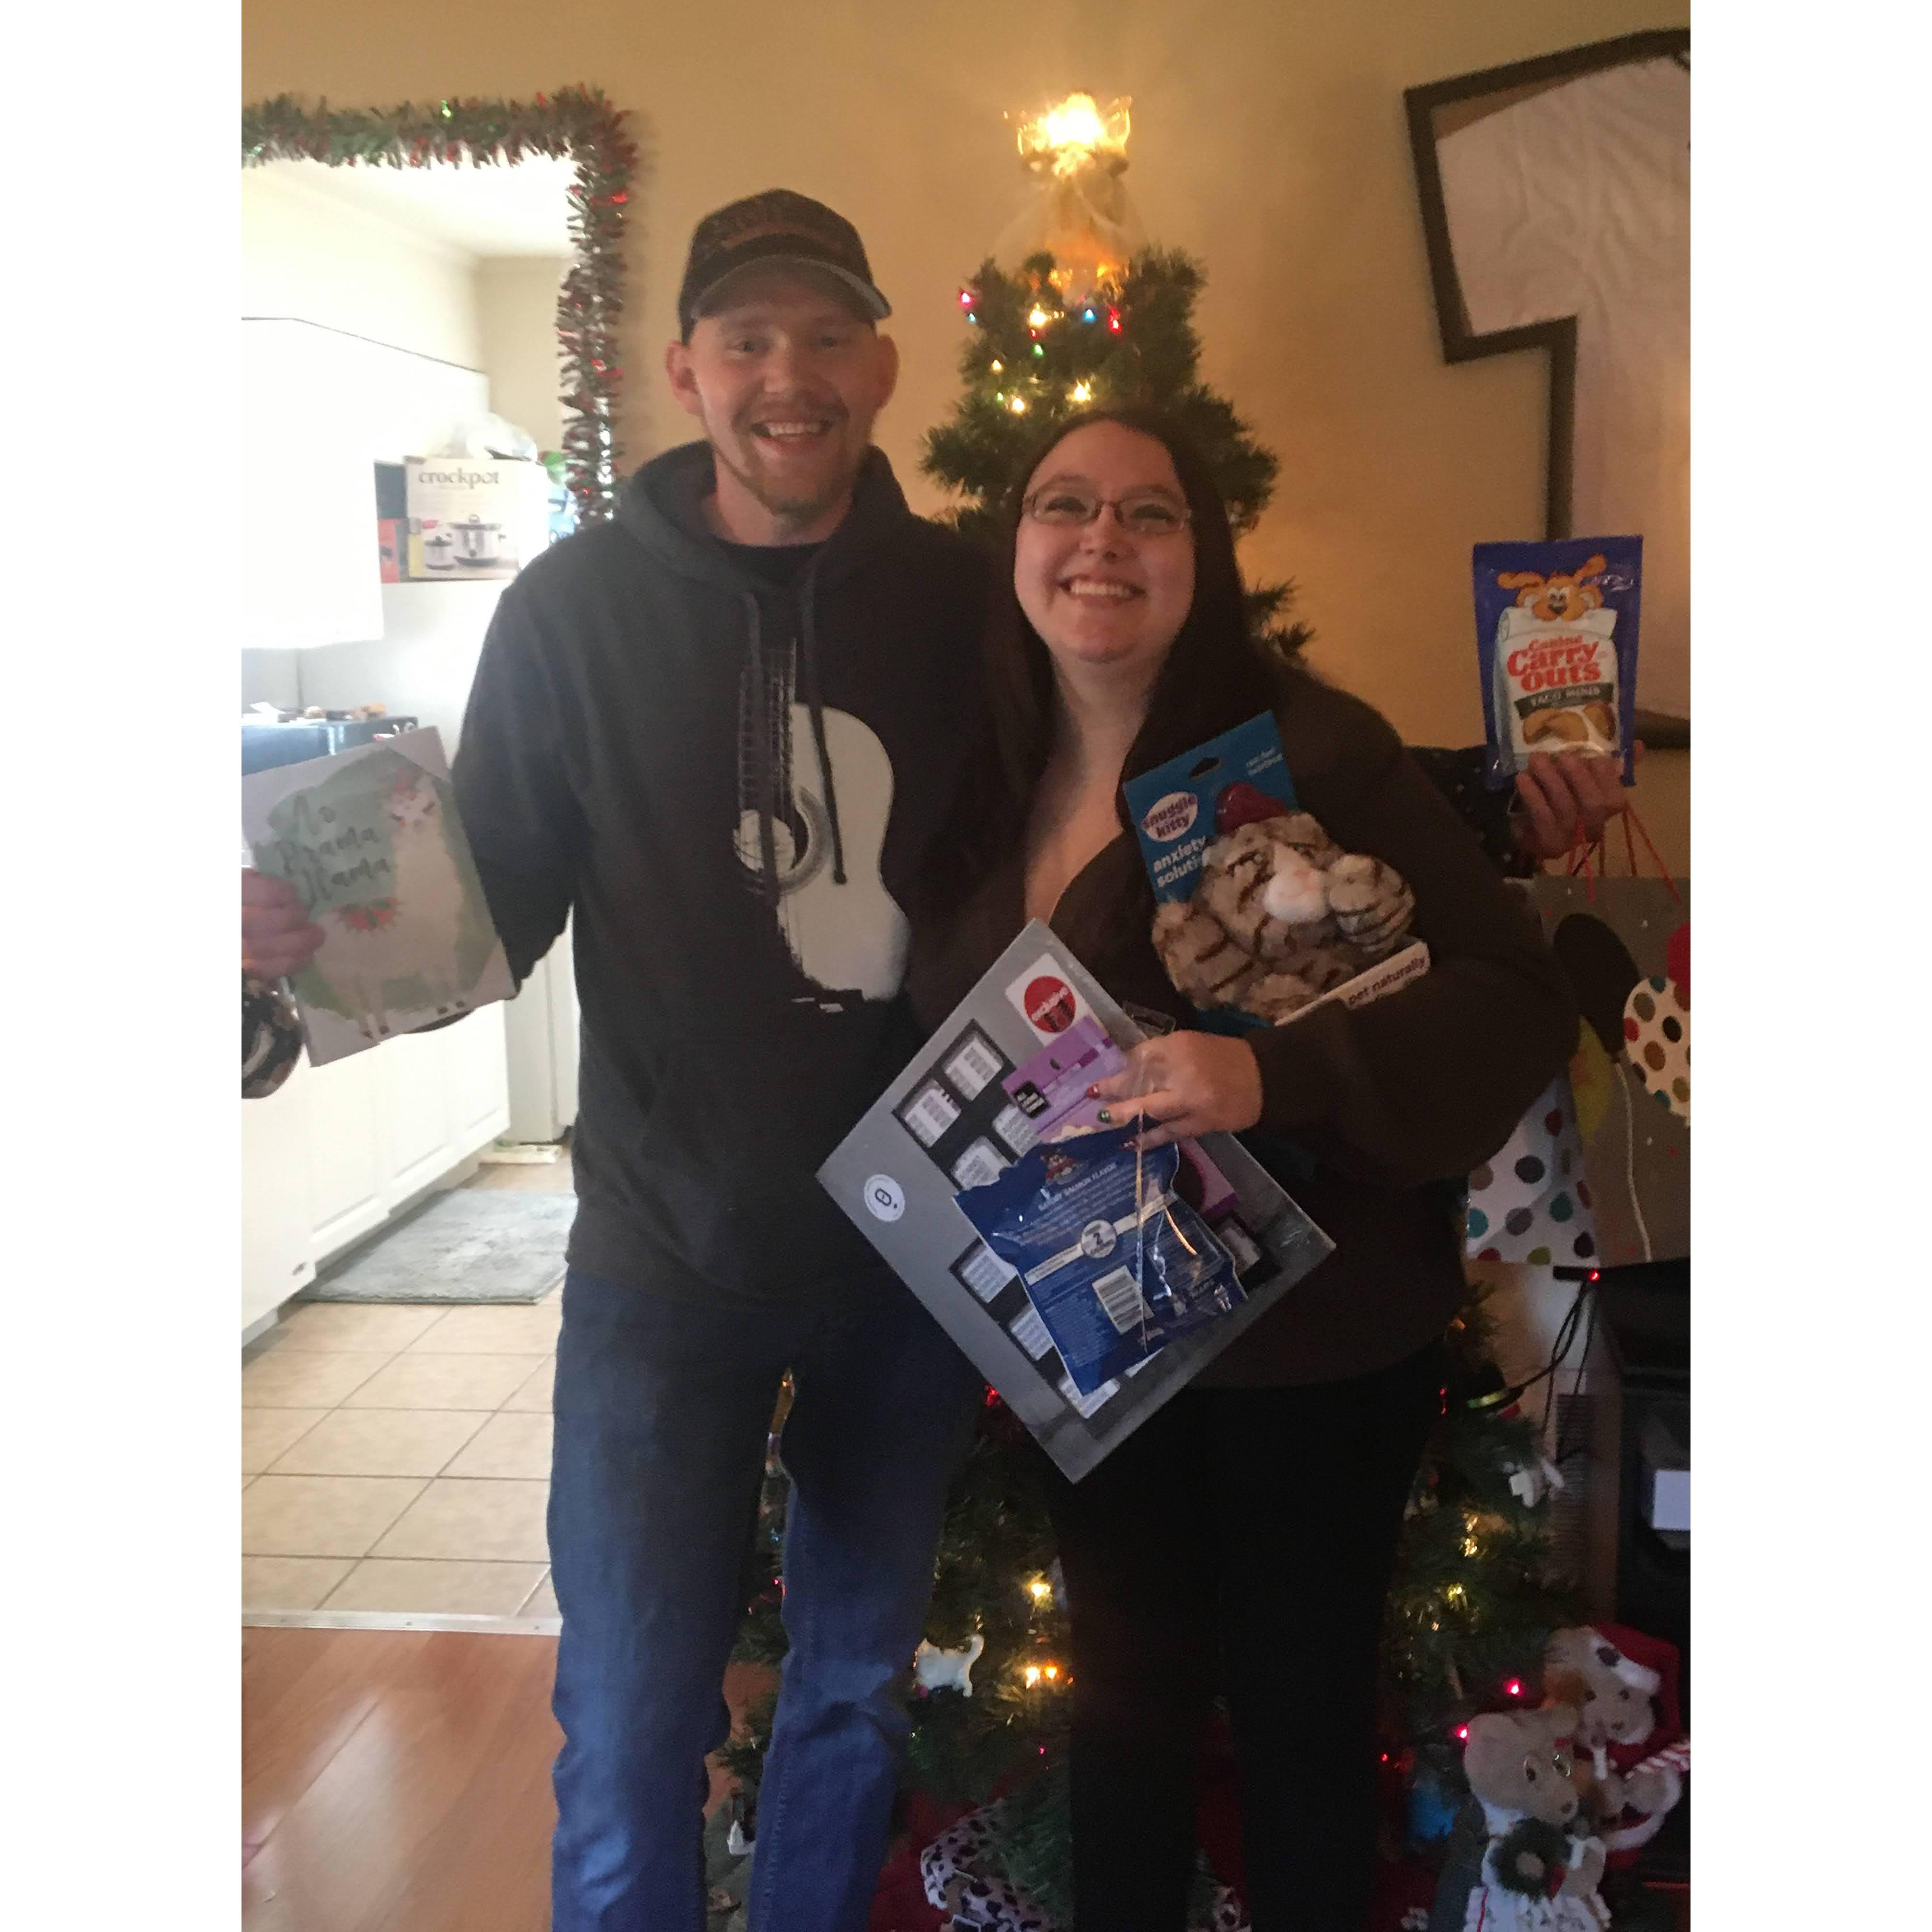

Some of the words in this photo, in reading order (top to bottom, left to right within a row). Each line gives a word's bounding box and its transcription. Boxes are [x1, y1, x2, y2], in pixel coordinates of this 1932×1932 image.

[418, 467, 499, 490] crockpot
[1507, 641, 1599, 677] Carry
[1141, 795, 1197, 828] snuggle
[1156, 815, 1189, 838] kitty
[1154, 835, 1207, 873] anxiety
[1349, 987, 1369, 1007] pet
[1372, 956, 1426, 992] naturally
[1092, 1232, 1103, 1245] 2
